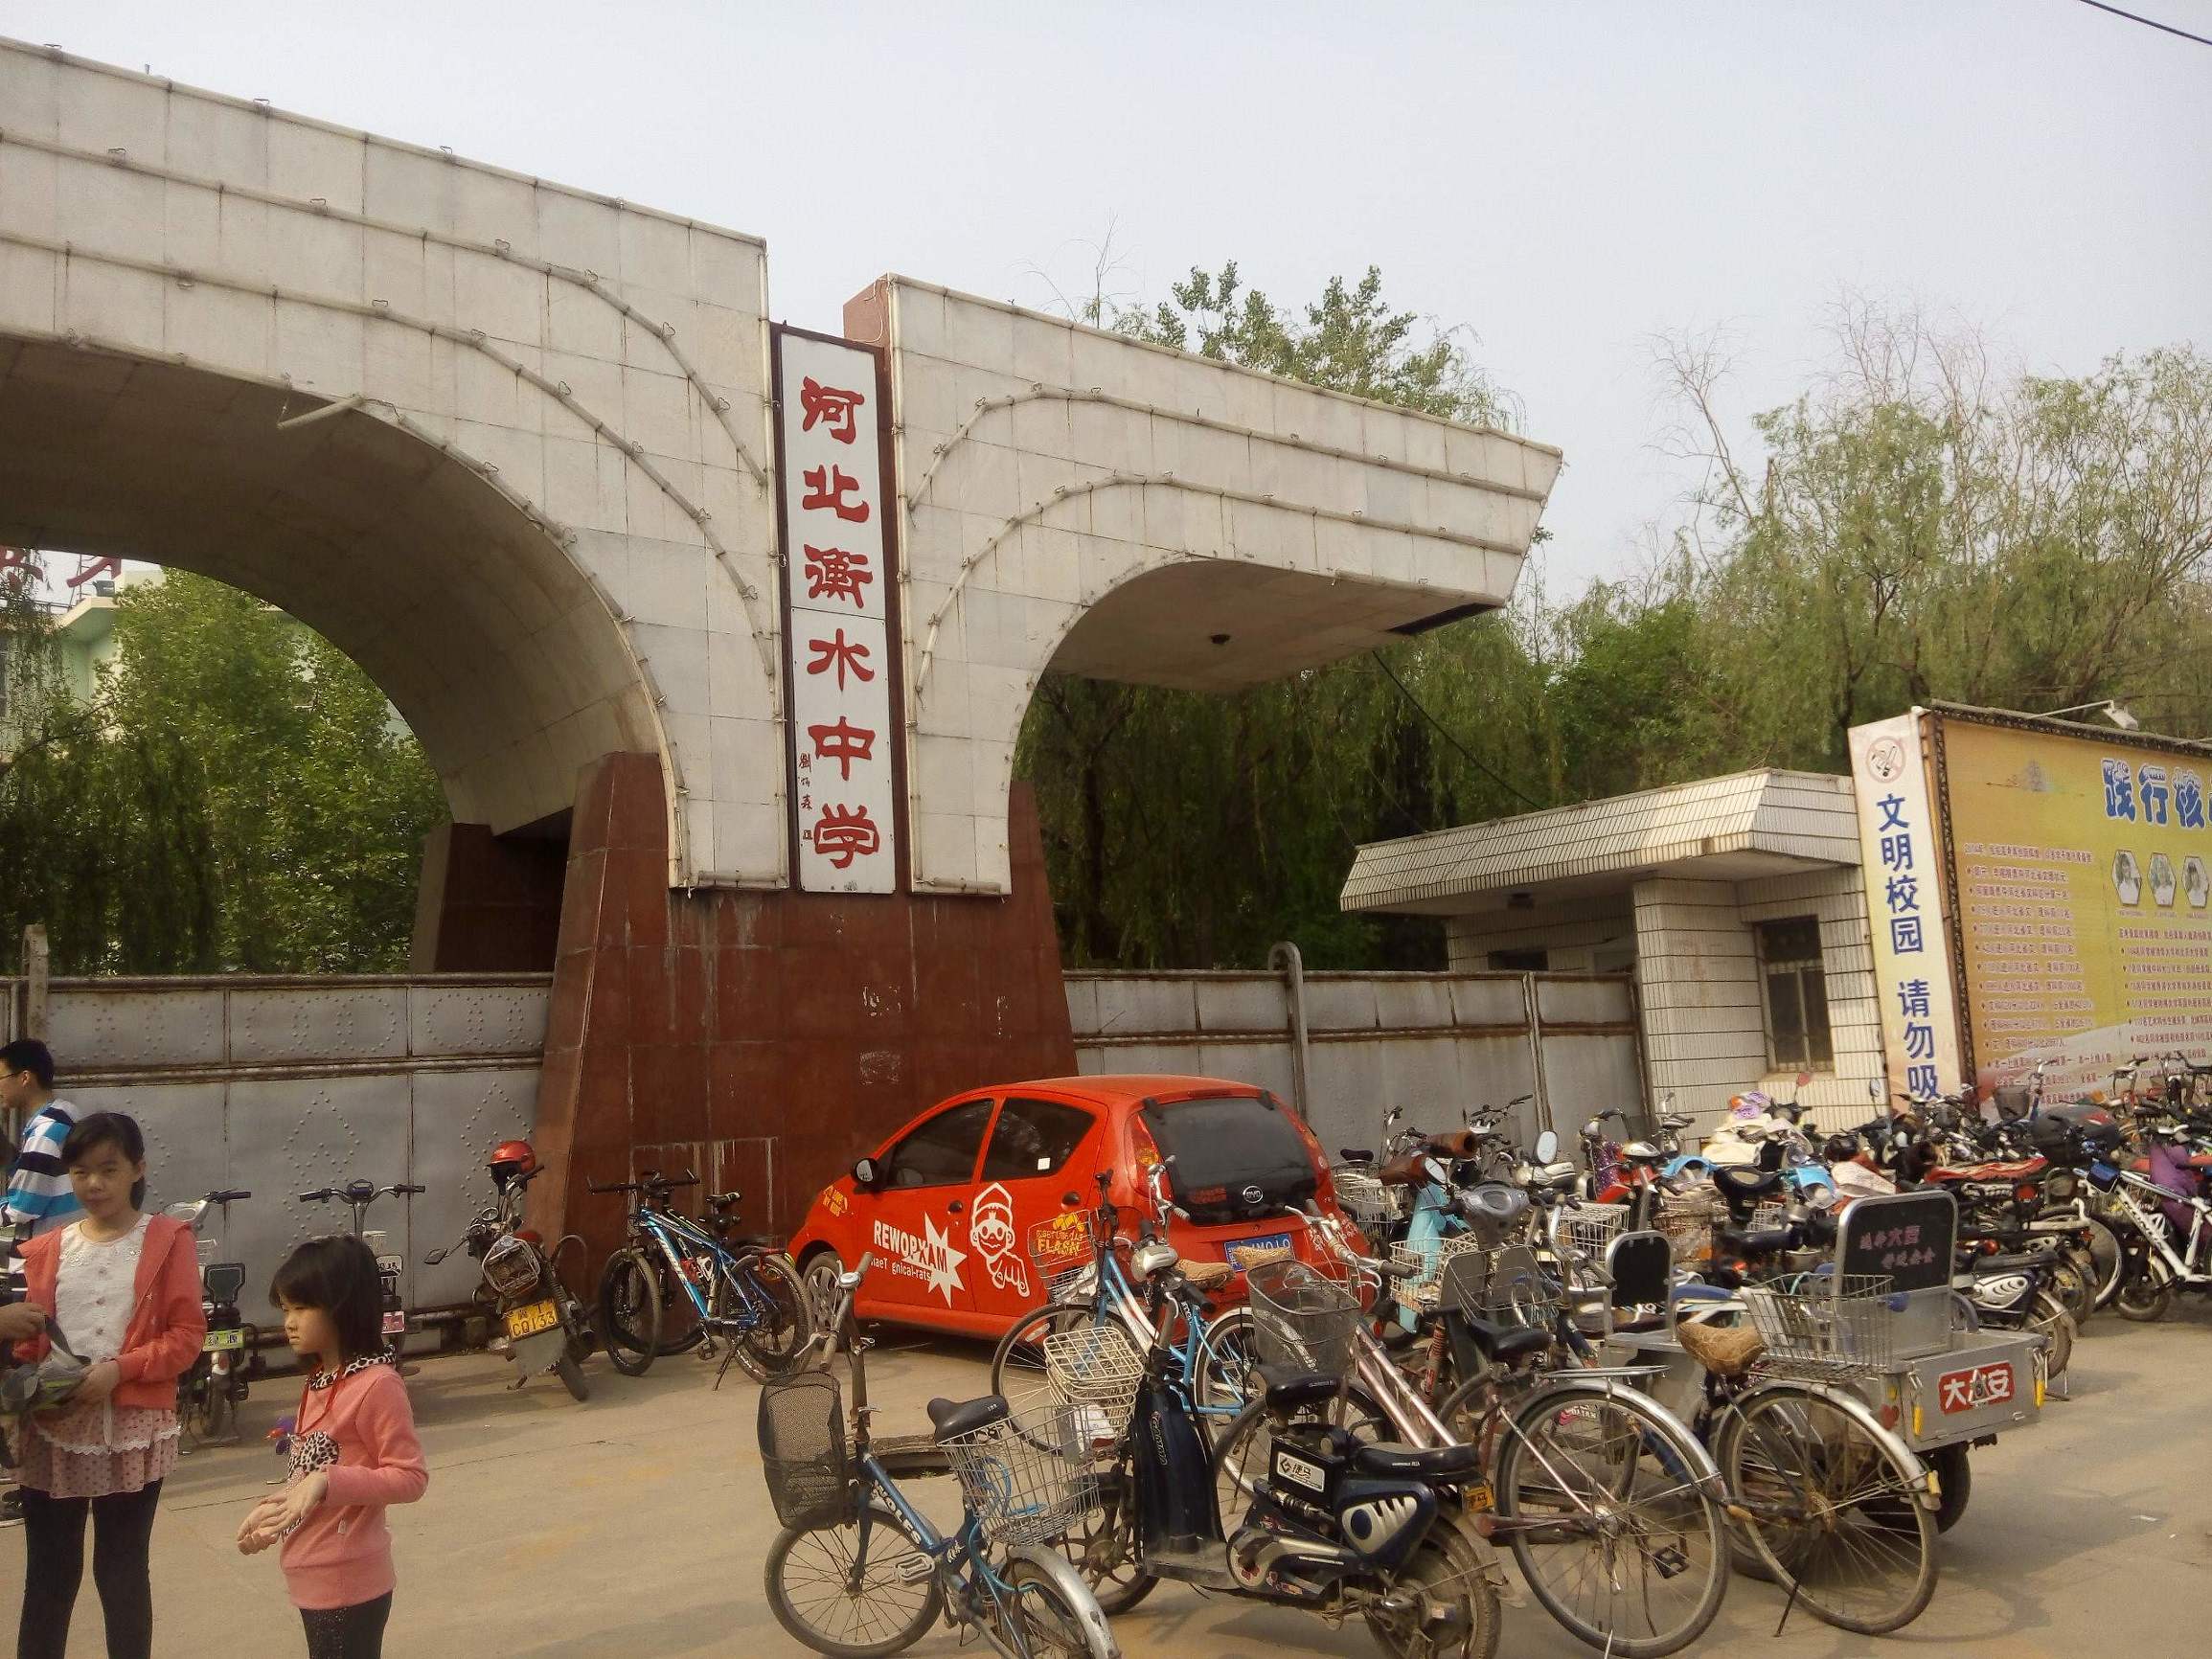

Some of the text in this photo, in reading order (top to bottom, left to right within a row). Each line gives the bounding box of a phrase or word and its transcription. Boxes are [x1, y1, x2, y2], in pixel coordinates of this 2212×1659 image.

[801, 375, 880, 869] 河北衡水中学
[1876, 793, 1924, 956] 文明校园
